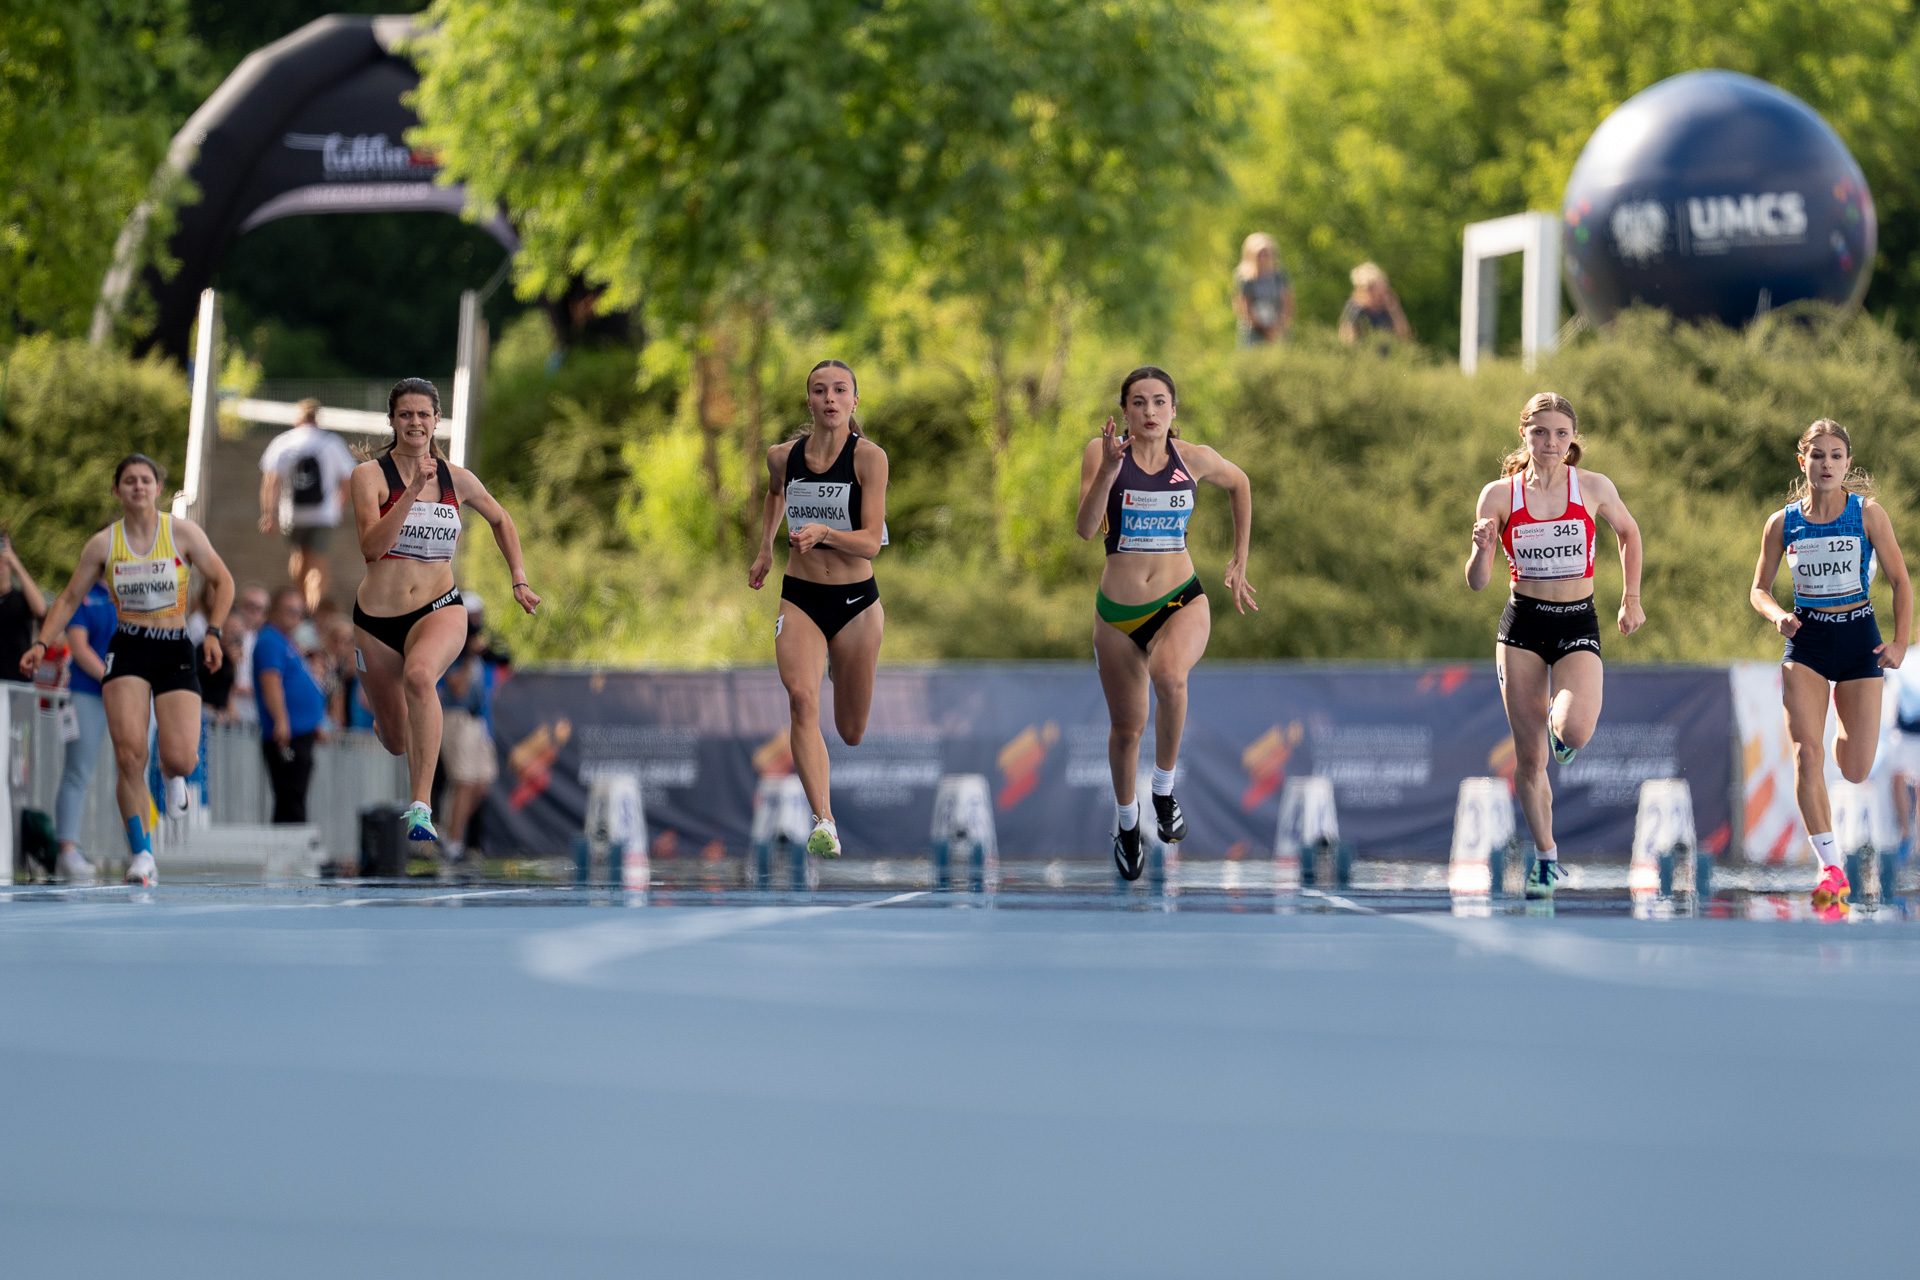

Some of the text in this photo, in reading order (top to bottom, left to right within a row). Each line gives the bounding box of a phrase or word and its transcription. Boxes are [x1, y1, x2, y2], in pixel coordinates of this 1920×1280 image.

[1688, 191, 1807, 240] UMCS
[818, 485, 843, 498] 597
[1170, 495, 1185, 507] 85
[434, 507, 454, 519] 405
[788, 505, 846, 520] GRABOWSKA
[1125, 515, 1188, 530] KASPRZAK
[1553, 524, 1579, 537] 345
[1517, 544, 1583, 560] WROTEK
[1828, 540, 1853, 552] 125
[151, 563, 166, 574] 37
[1798, 560, 1852, 577] CIUPAK
[117, 579, 175, 595] CZUPRYŃSKA
[432, 594, 452, 611] NIKE
[1535, 603, 1588, 613] NIKE PRO
[1807, 611, 1849, 623] NIKE
[144, 626, 181, 640] NIKE
